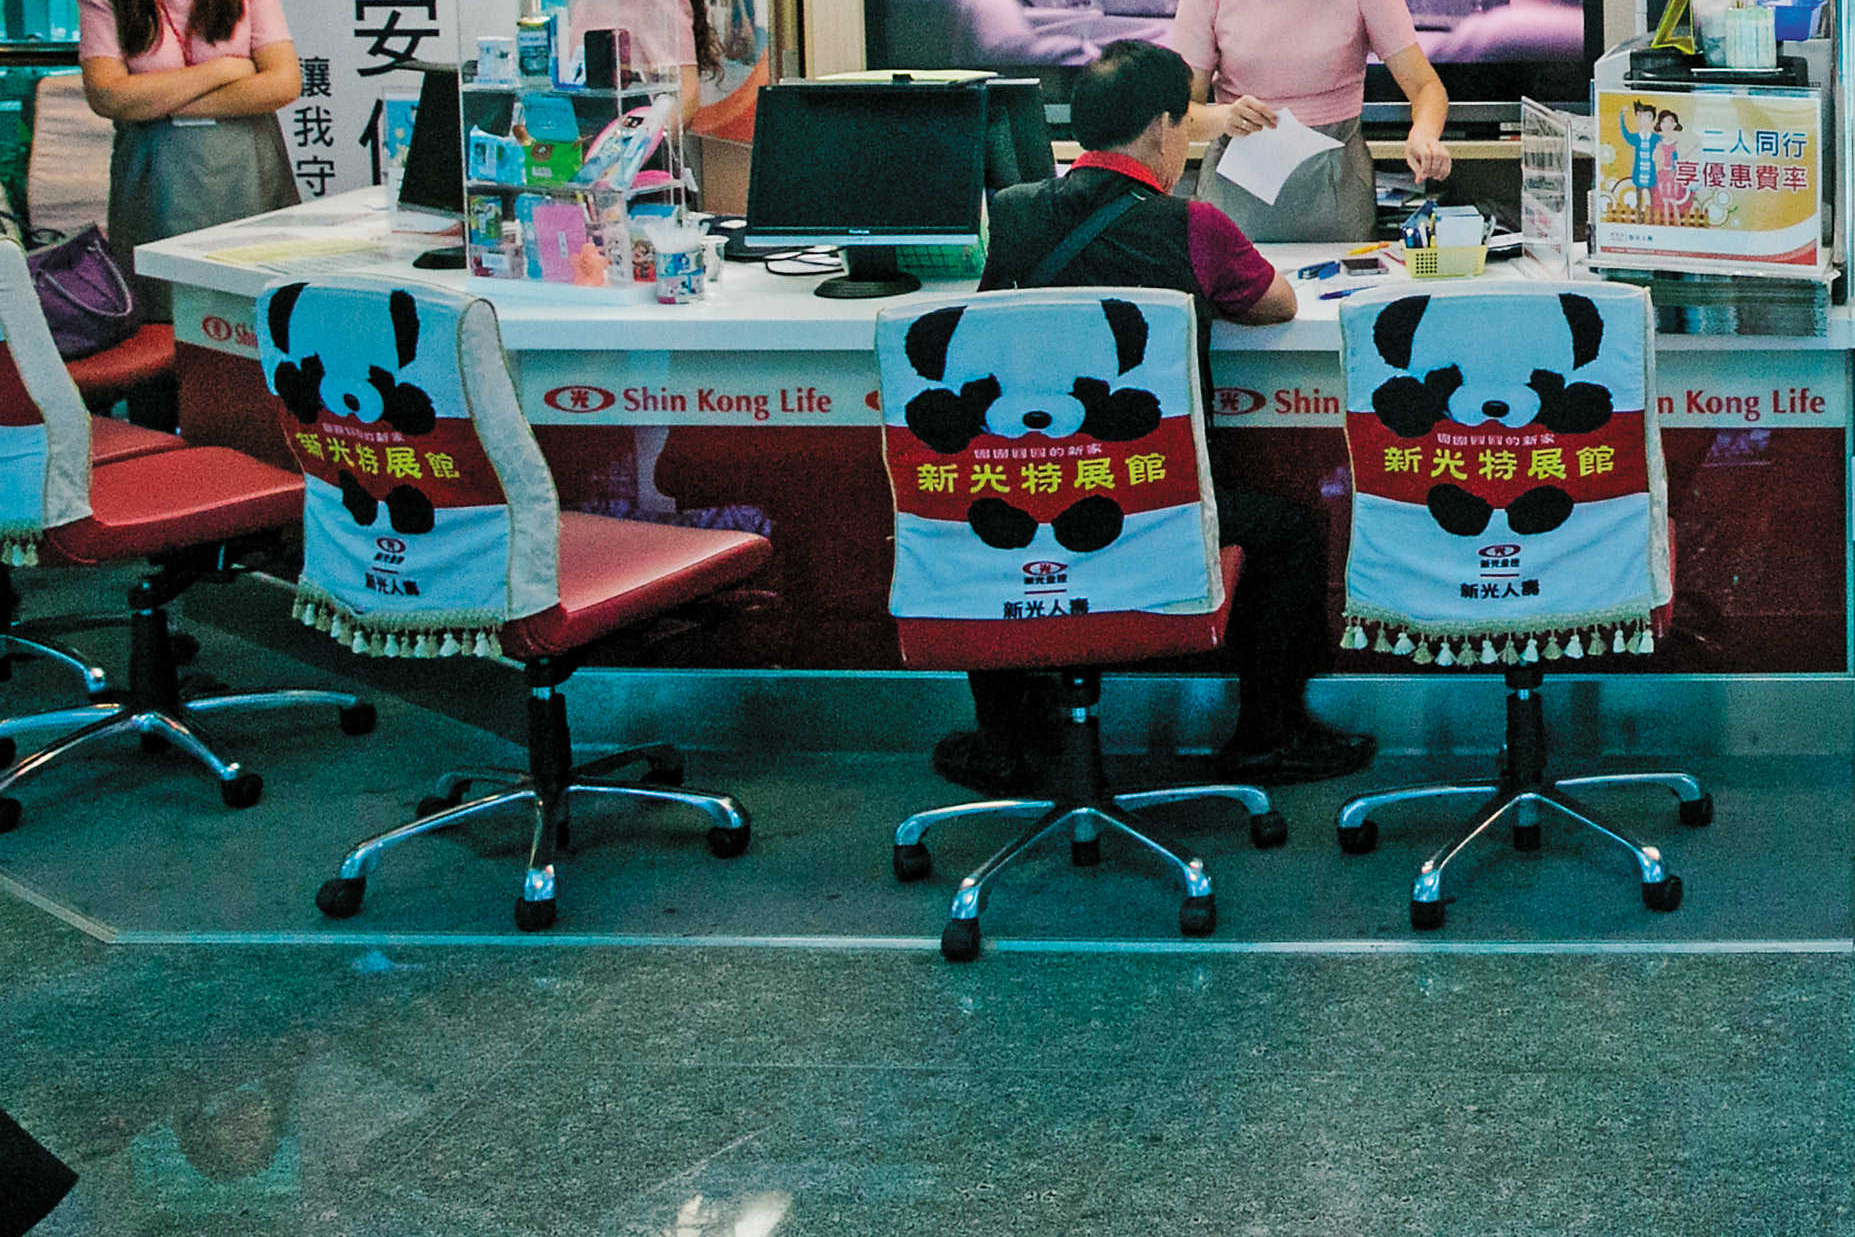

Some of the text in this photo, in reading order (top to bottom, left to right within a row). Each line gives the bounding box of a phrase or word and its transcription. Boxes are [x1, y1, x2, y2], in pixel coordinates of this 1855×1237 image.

[1701, 129, 1808, 160] 二人同行
[1674, 161, 1809, 193] 享優惠費率
[622, 388, 687, 413] Shin
[697, 388, 770, 421] Kong
[781, 387, 832, 414] Life
[1273, 387, 1340, 415] Shin
[1685, 390, 1762, 421] Kong
[1772, 388, 1826, 415] Life
[296, 432, 460, 480] 新光特展館
[1383, 444, 1615, 481] 新光特展館
[917, 452, 1166, 496] 新光特展館
[1460, 579, 1541, 599] 新光人壽
[1003, 597, 1090, 620] 新光人壽
